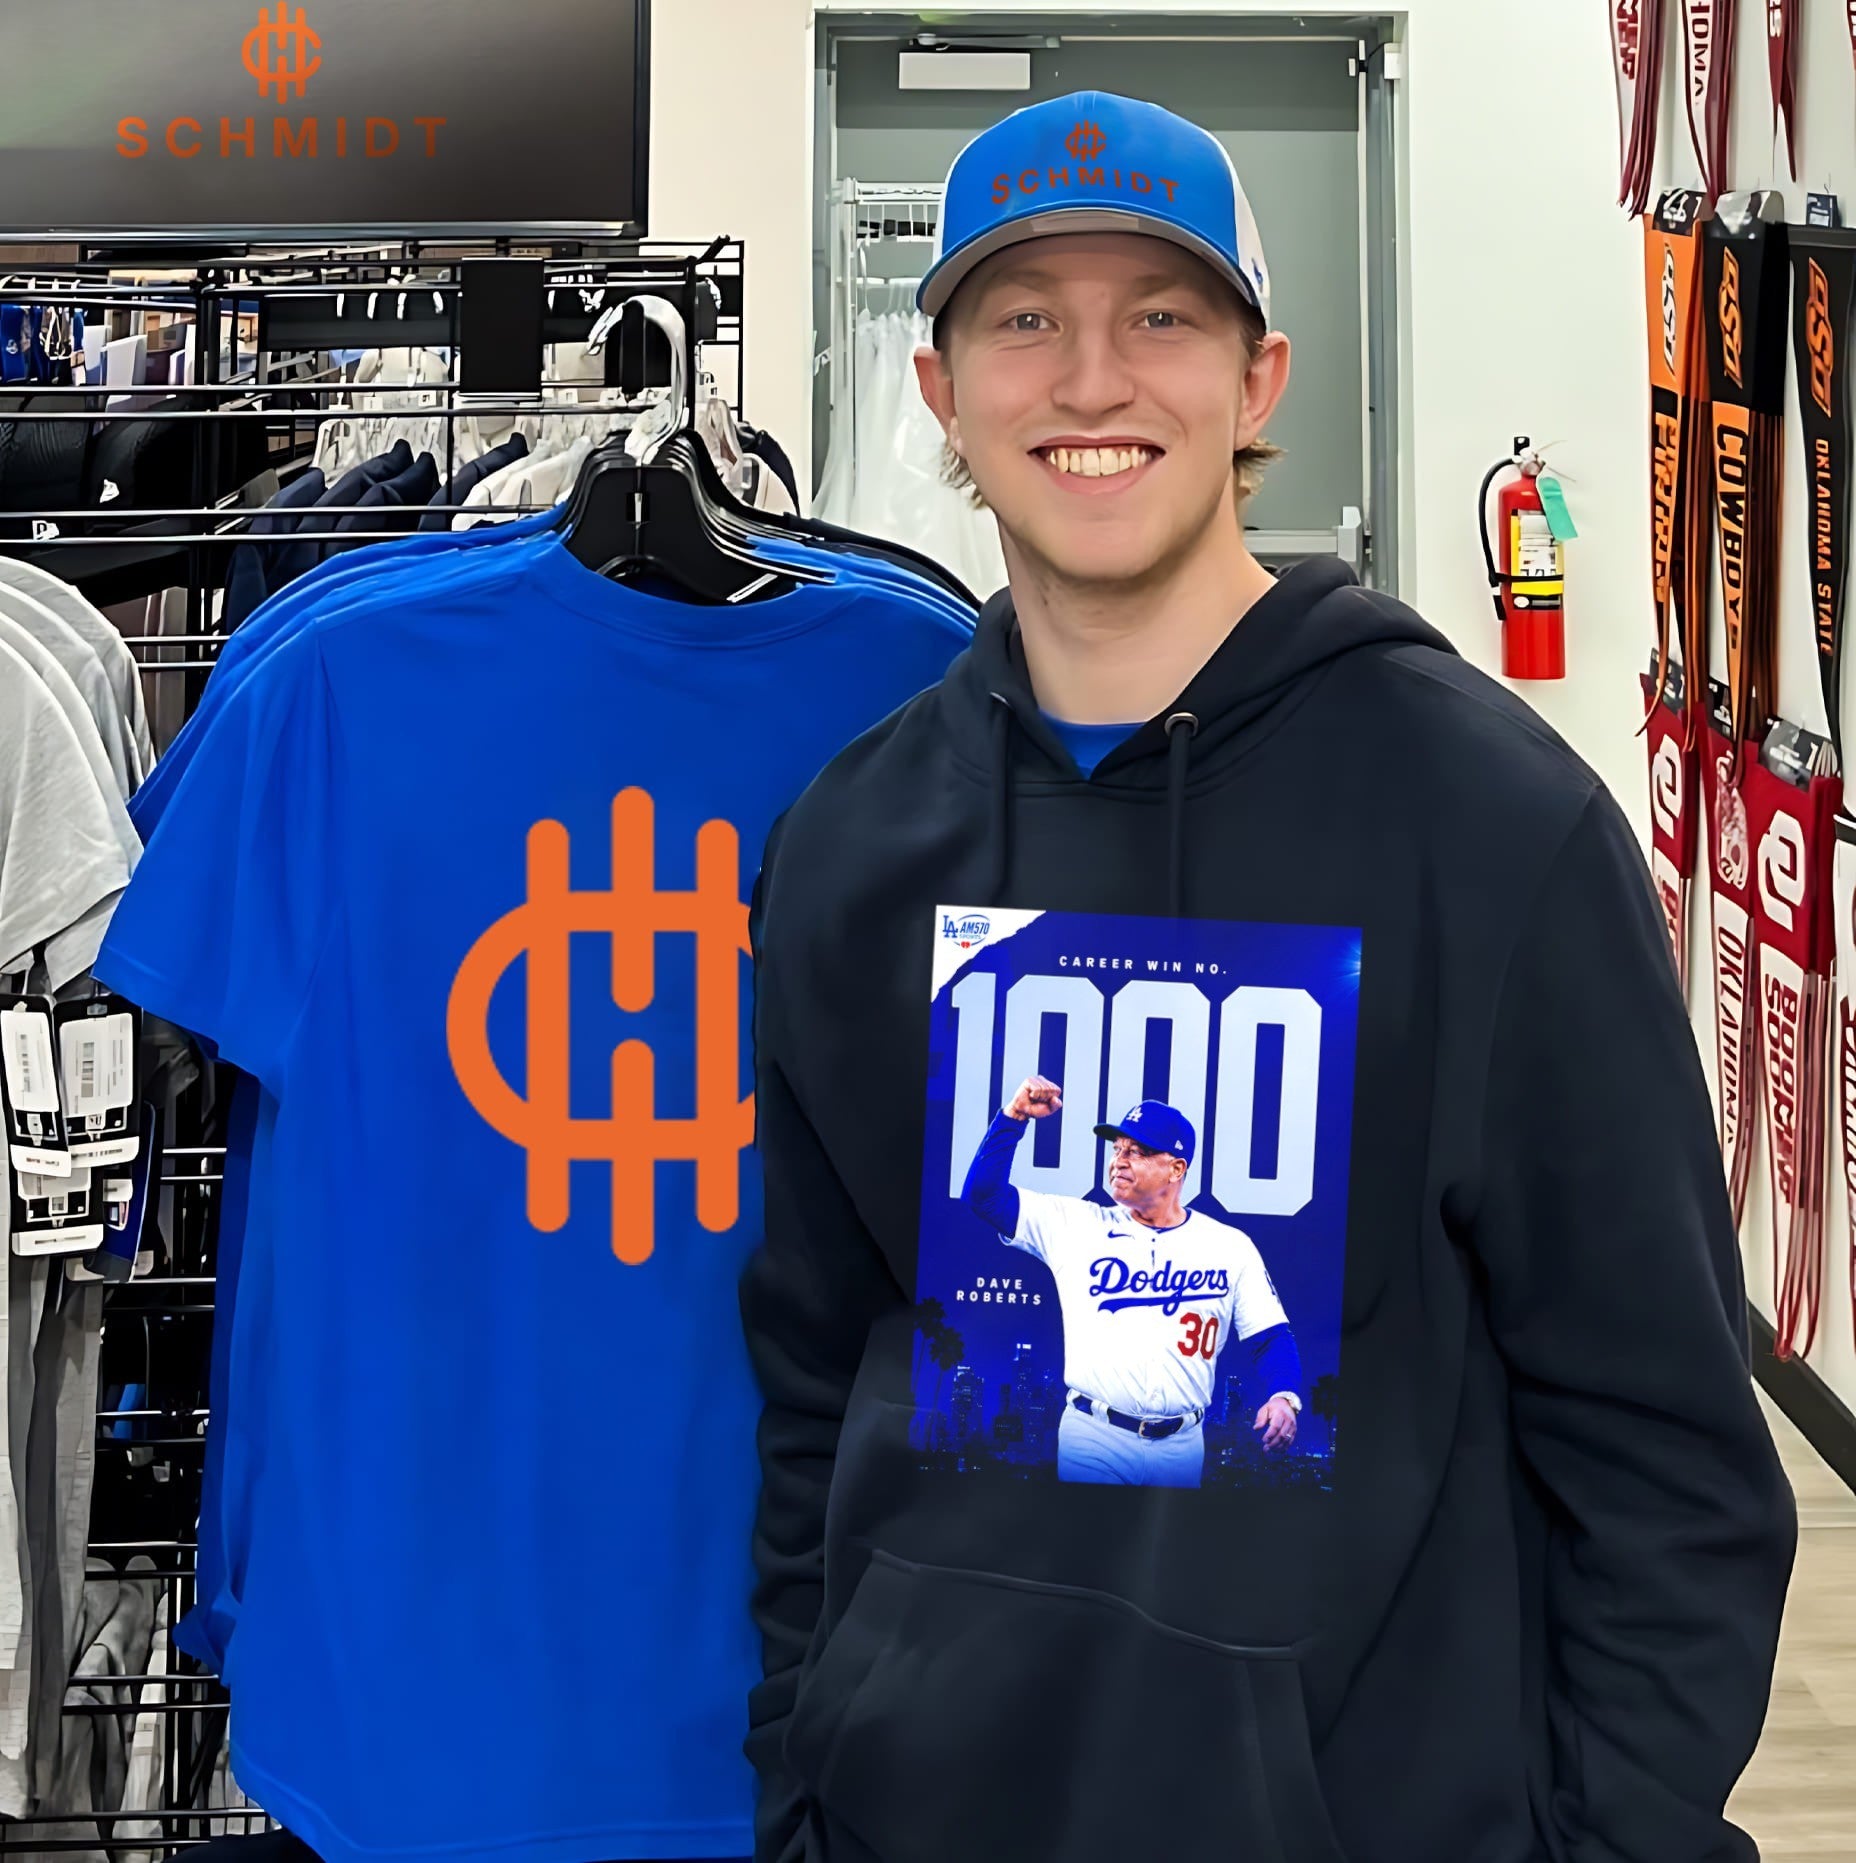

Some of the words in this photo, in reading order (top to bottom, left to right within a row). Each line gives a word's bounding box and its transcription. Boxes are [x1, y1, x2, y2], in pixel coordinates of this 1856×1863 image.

[116, 116, 447, 158] SCHMIDT
[992, 167, 1179, 204] SCHMIDT
[960, 921, 990, 935] AM570
[1059, 955, 1133, 970] CAREER
[1147, 960, 1182, 972] WIN
[1195, 962, 1227, 975] NO.
[949, 971, 1322, 1217] 1000
[956, 1290, 1041, 1306] ROBERTS
[976, 1277, 1022, 1290] DAVE
[1089, 1257, 1229, 1316] Dodgers
[1177, 1312, 1219, 1360] 30
